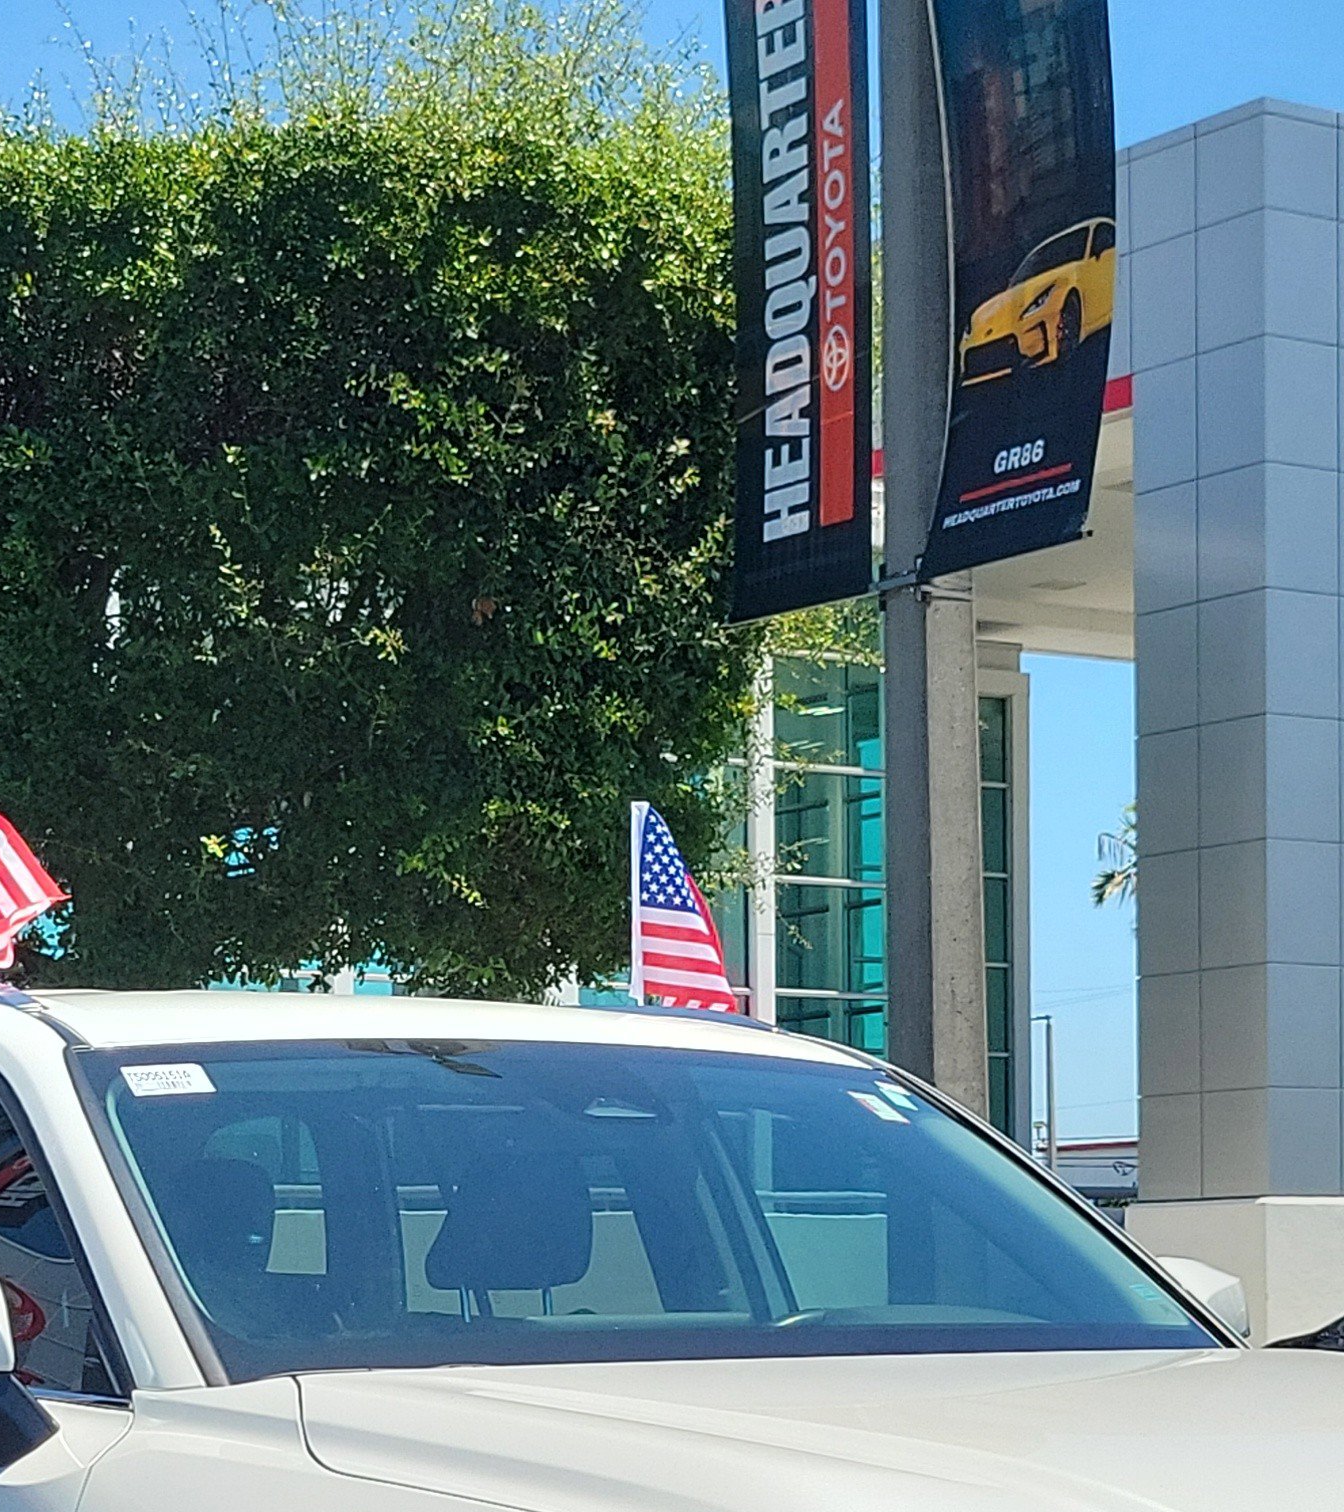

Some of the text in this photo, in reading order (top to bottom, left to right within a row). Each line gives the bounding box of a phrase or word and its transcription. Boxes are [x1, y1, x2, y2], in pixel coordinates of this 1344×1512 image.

[822, 100, 848, 316] TOYOTA
[994, 439, 1046, 474] GR86
[942, 479, 1081, 529] HEADQUARTERTOYOTA.COM
